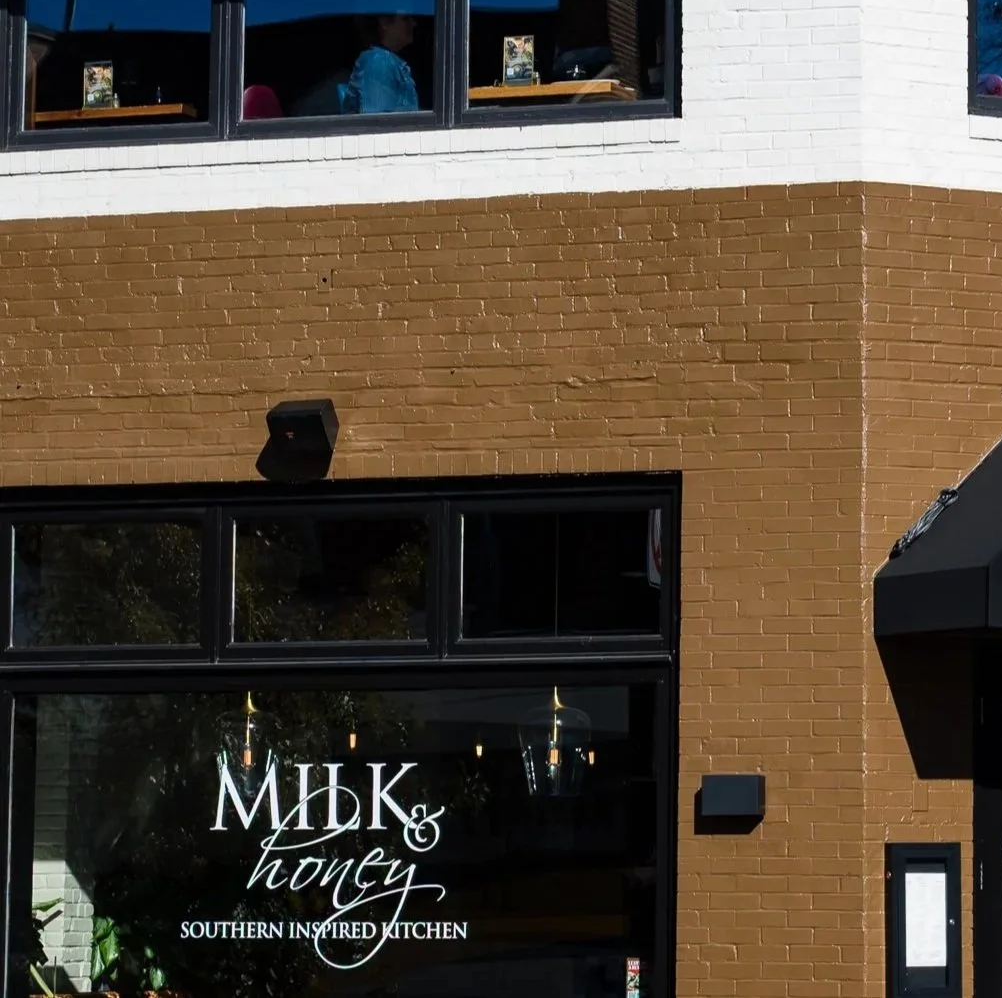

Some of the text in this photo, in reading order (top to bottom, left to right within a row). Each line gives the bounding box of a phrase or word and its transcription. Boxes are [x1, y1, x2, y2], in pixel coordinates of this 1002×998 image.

[180, 920, 468, 940] SOUTHERN INSPIRED KITCHEN
